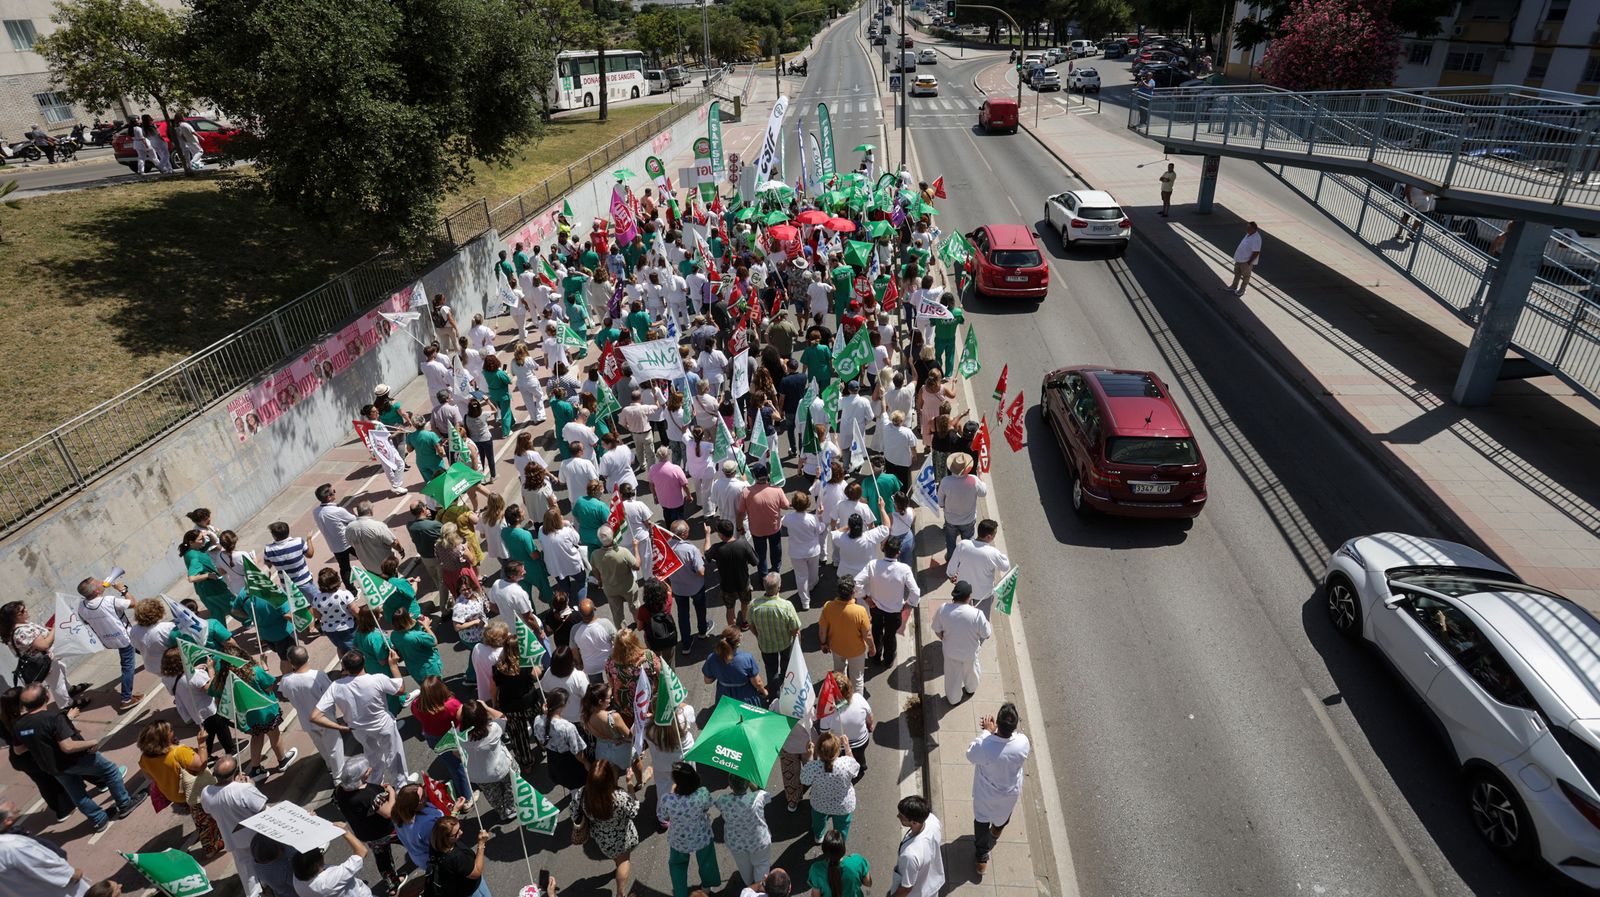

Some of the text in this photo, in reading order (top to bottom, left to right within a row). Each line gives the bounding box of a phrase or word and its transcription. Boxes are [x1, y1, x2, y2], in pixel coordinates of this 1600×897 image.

[711, 124, 720, 166] SATSE
[296, 372, 318, 394] VOTA
[256, 398, 282, 422] VOTA
[712, 756, 739, 770] Cádiz
[715, 745, 742, 762] SATSE
